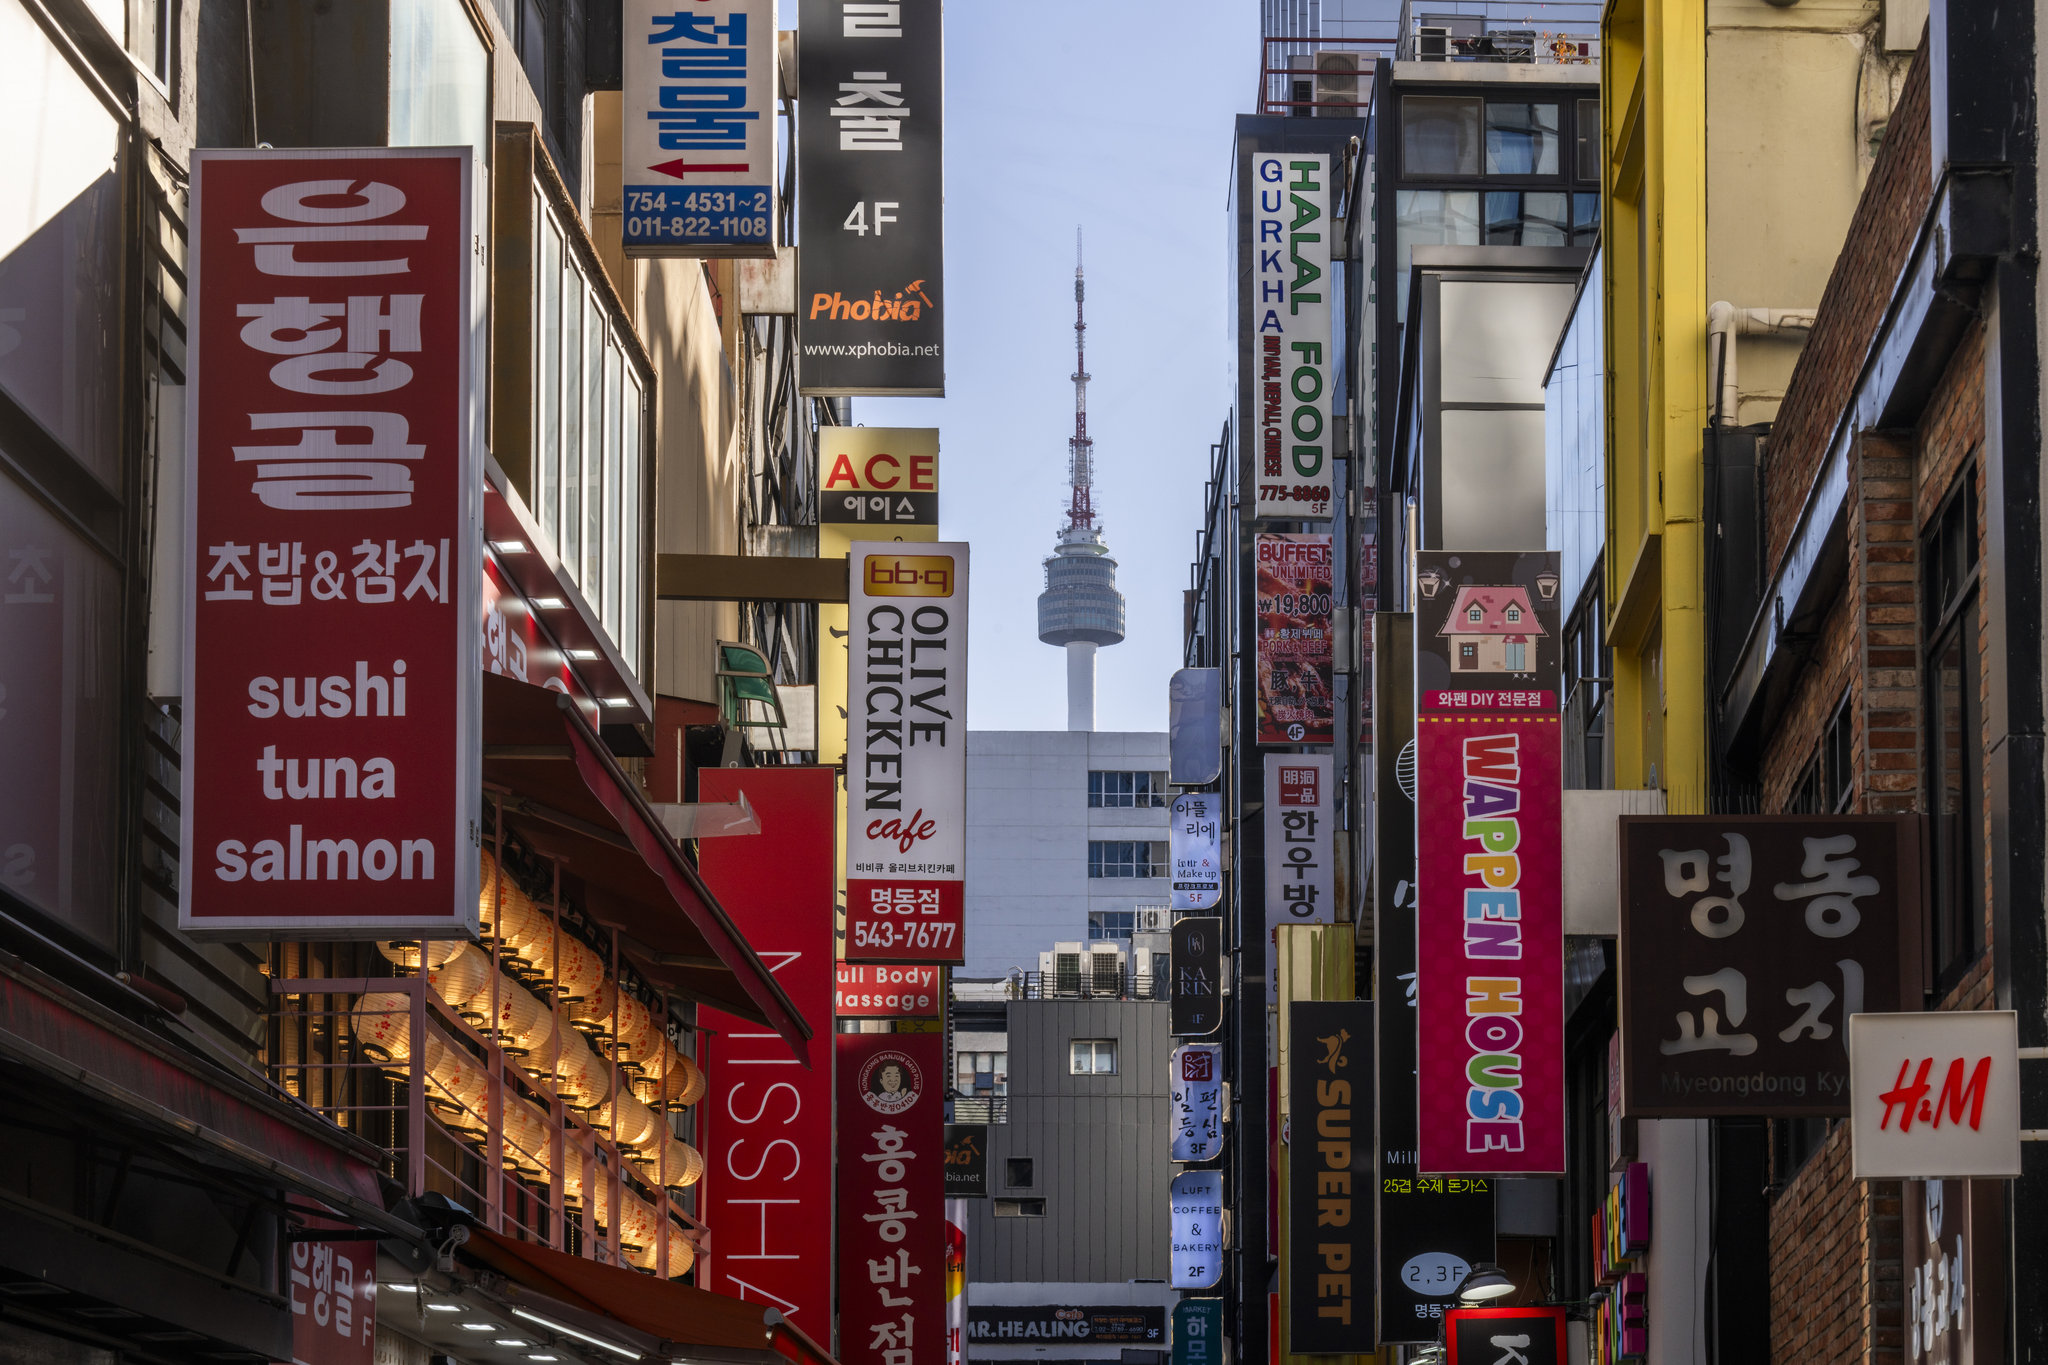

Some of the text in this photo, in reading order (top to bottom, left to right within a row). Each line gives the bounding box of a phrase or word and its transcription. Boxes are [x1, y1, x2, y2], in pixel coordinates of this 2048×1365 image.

[647, 12, 760, 151] 철물
[628, 216, 767, 237] 011-822-1108
[843, 201, 899, 236] 4F
[1259, 158, 1284, 333] GURKHA
[810, 289, 921, 322] Phobia
[1289, 160, 1323, 478] HALAL FOOD
[232, 179, 430, 511] 은행골
[804, 342, 940, 360] www.xphobia.net
[1264, 427, 1282, 477] CHINESE
[825, 454, 934, 490] ACE
[1259, 485, 1330, 501] 775-8860
[844, 496, 915, 521] 에이스
[1312, 503, 1327, 514] 5F
[1258, 542, 1330, 562] BUFFET
[205, 538, 450, 605] 초밥&참치
[1272, 565, 1331, 579] UNLIMITED
[1262, 640, 1291, 654] PORK
[1302, 640, 1328, 654] BEEF
[909, 605, 953, 747] OLIVE
[249, 659, 407, 719] sushi
[1438, 691, 1541, 708] 와펜 DIY 전문점
[865, 604, 905, 812] CHICKEN
[1288, 726, 1303, 739] 4F
[257, 745, 396, 799] tuna
[1282, 769, 1316, 786] 明洞
[866, 808, 937, 854] cafe
[1186, 821, 1215, 841] 리에
[215, 824, 435, 882] salmon
[1202, 858, 1210, 867] &
[1281, 810, 1321, 918] 한우방
[856, 863, 955, 874] 비비큐 올리브치킨카페
[1177, 869, 1217, 880] Make up
[1189, 893, 1203, 902] 5F
[1657, 832, 1881, 939] 명동
[871, 888, 940, 915] 명동점
[855, 921, 956, 948] 543-7677
[1462, 731, 1525, 1154] WAPPEN HOUSE
[836, 967, 932, 987] ull Body
[1660, 1071, 1807, 1097] Myeongdong
[1879, 1055, 1992, 1132] H&M
[1190, 1143, 1207, 1154] 3F
[1182, 1186, 1211, 1195] LUFT
[1384, 1178, 1488, 1193] 25겹 수제 돈가스
[1173, 1206, 1220, 1215] COFFEE
[1316, 1079, 1352, 1326] SUPER PET
[1191, 1224, 1202, 1236] &
[861, 1124, 922, 1365] 홍콩반점
[1173, 1243, 1219, 1252] BAKERY
[1188, 1266, 1205, 1277] 2F
[1410, 1266, 1464, 1284] 2,3F
[1147, 1328, 1159, 1339] 3F
[1186, 1316, 1208, 1365] 하모
